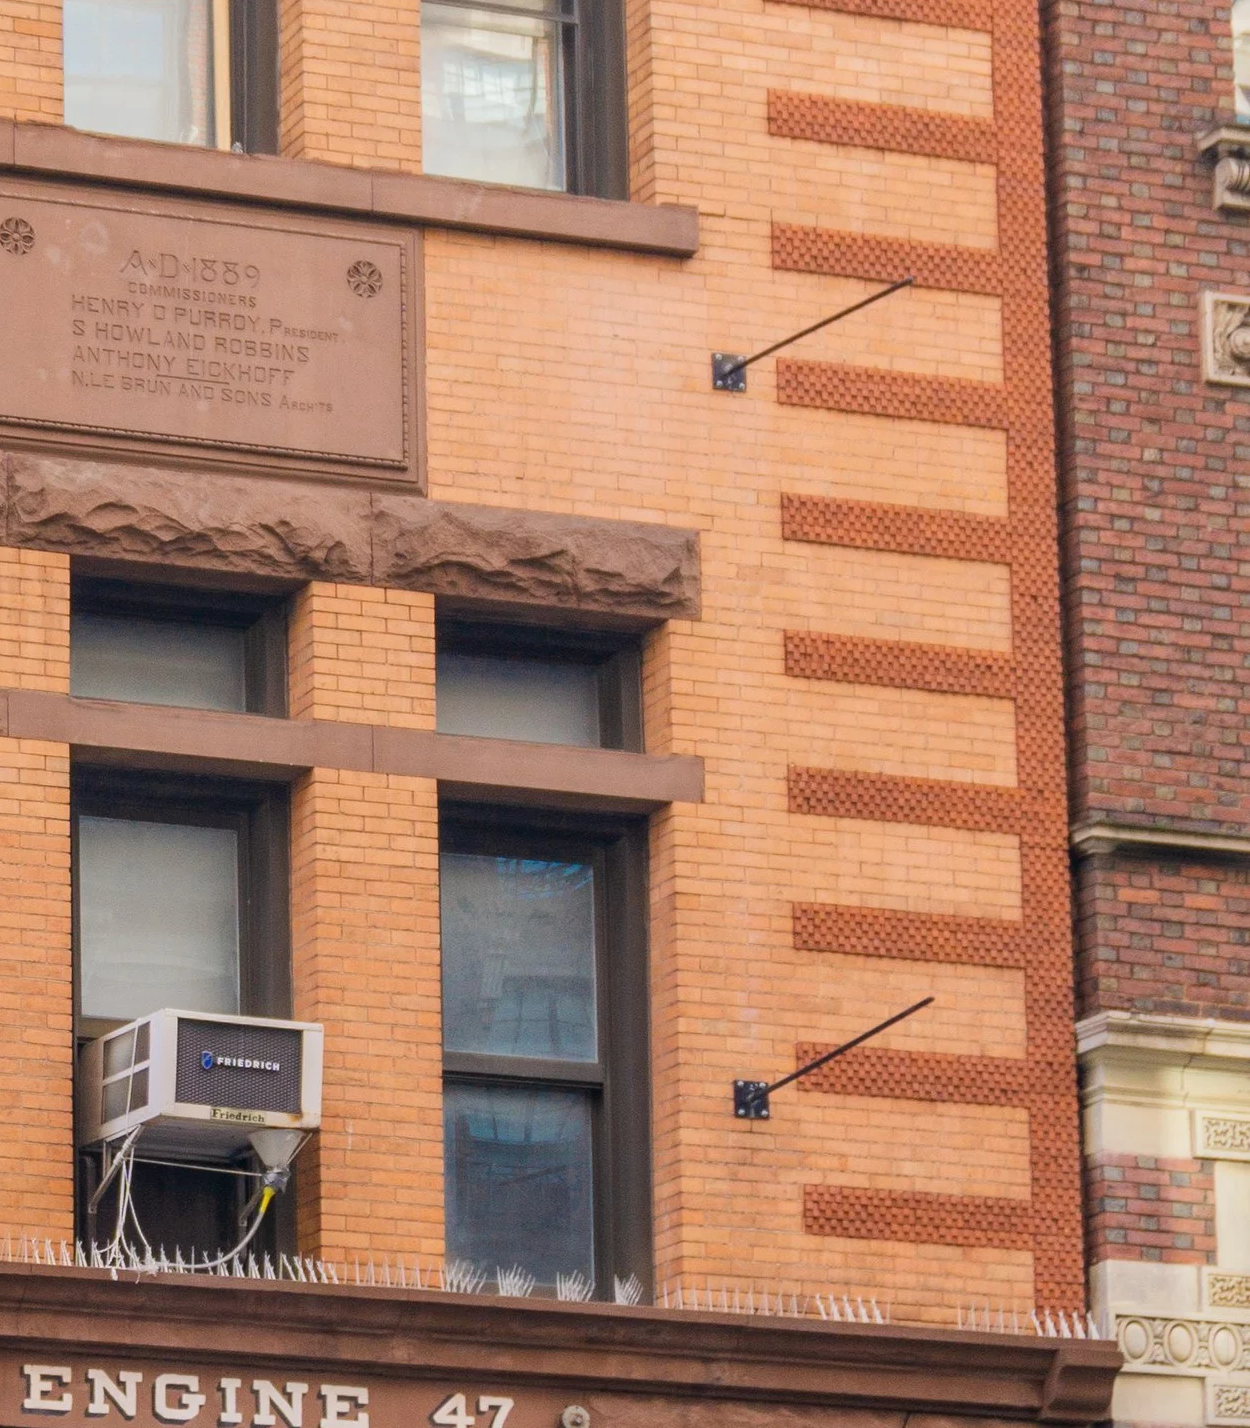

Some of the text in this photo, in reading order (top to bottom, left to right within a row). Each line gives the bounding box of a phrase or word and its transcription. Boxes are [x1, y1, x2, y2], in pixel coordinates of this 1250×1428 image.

[71, 294, 143, 318] HENRY
[128, 282, 256, 308] COMMISSIONERS
[95, 322, 206, 351] HOWLAND
[215, 336, 309, 362] ROBBINS
[73, 346, 294, 385] ANTHONY EICKHOFF
[121, 376, 171, 396] BRUN
[179, 383, 214, 400] AND
[222, 387, 271, 407] SONS
[216, 1057, 280, 1072] FRIEDRICH
[212, 1108, 265, 1122] Friedrich
